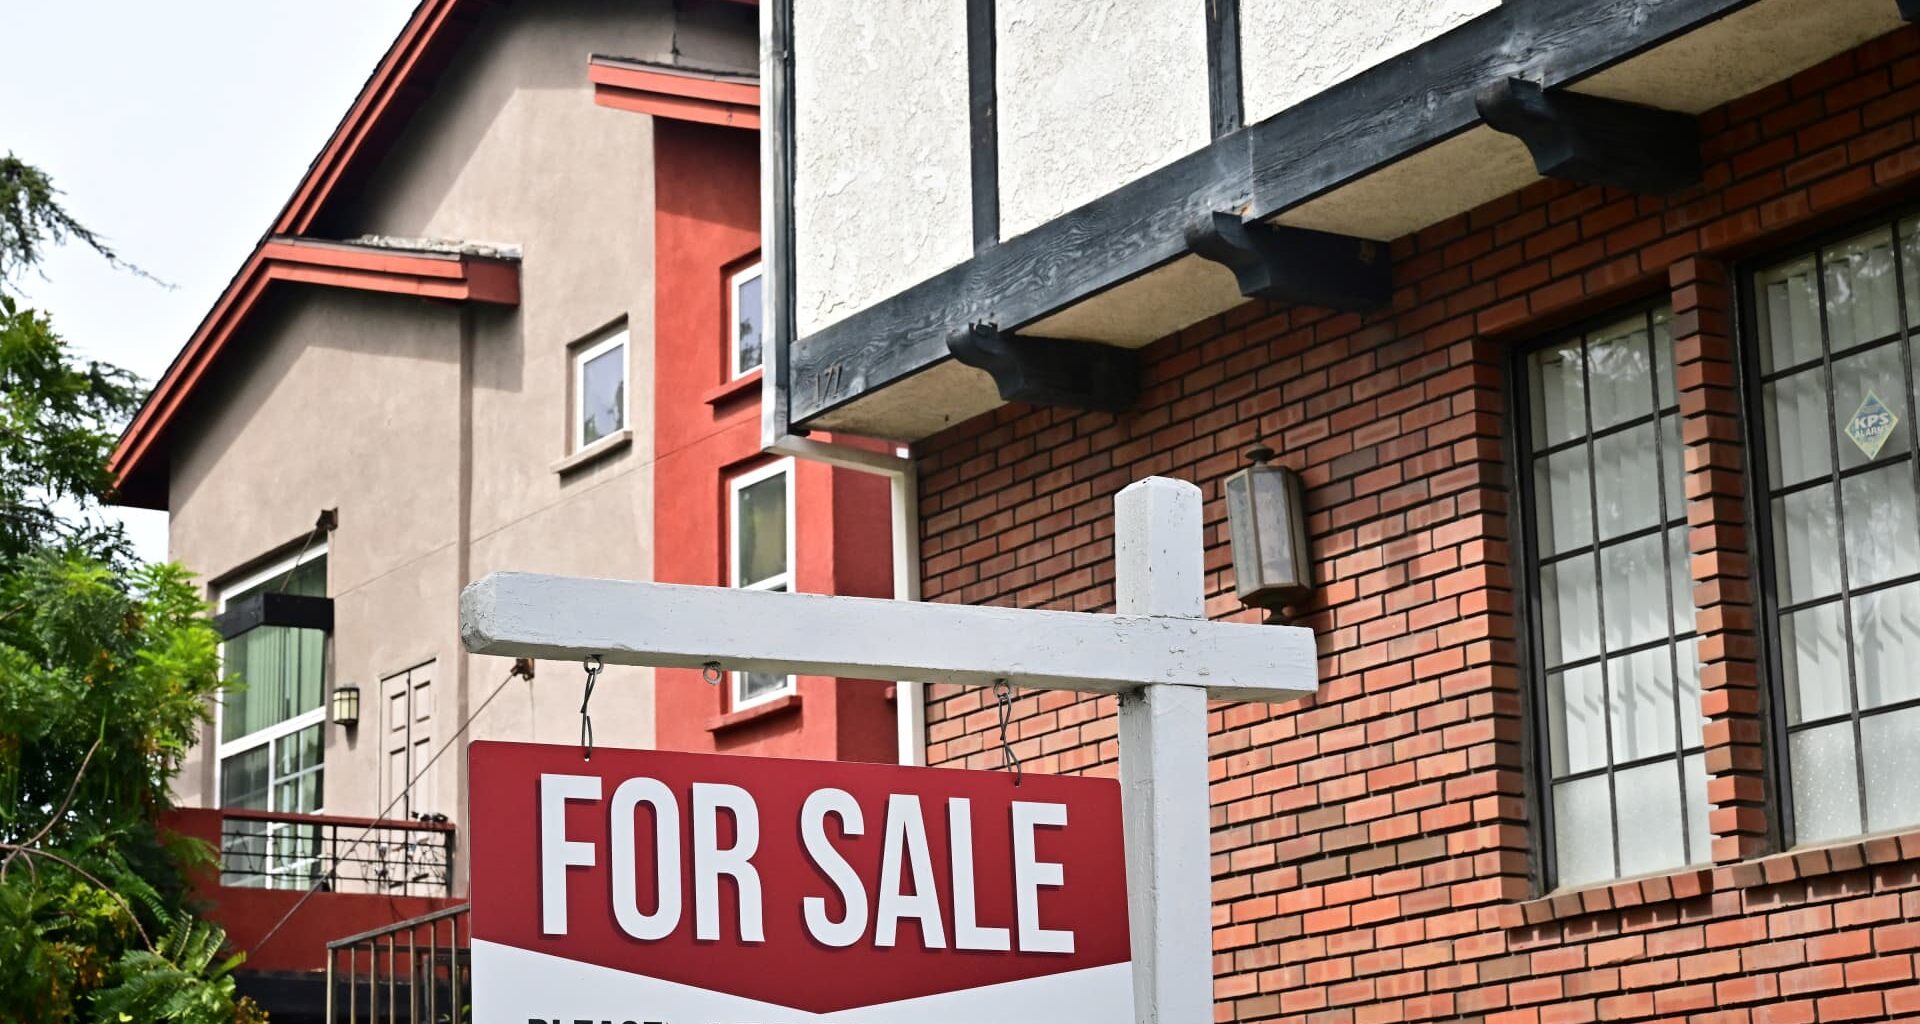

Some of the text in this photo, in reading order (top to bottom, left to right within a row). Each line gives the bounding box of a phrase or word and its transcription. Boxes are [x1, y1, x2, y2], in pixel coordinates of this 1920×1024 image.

[1855, 413, 1889, 430] KPS
[540, 773, 1076, 954] FOR SALE
